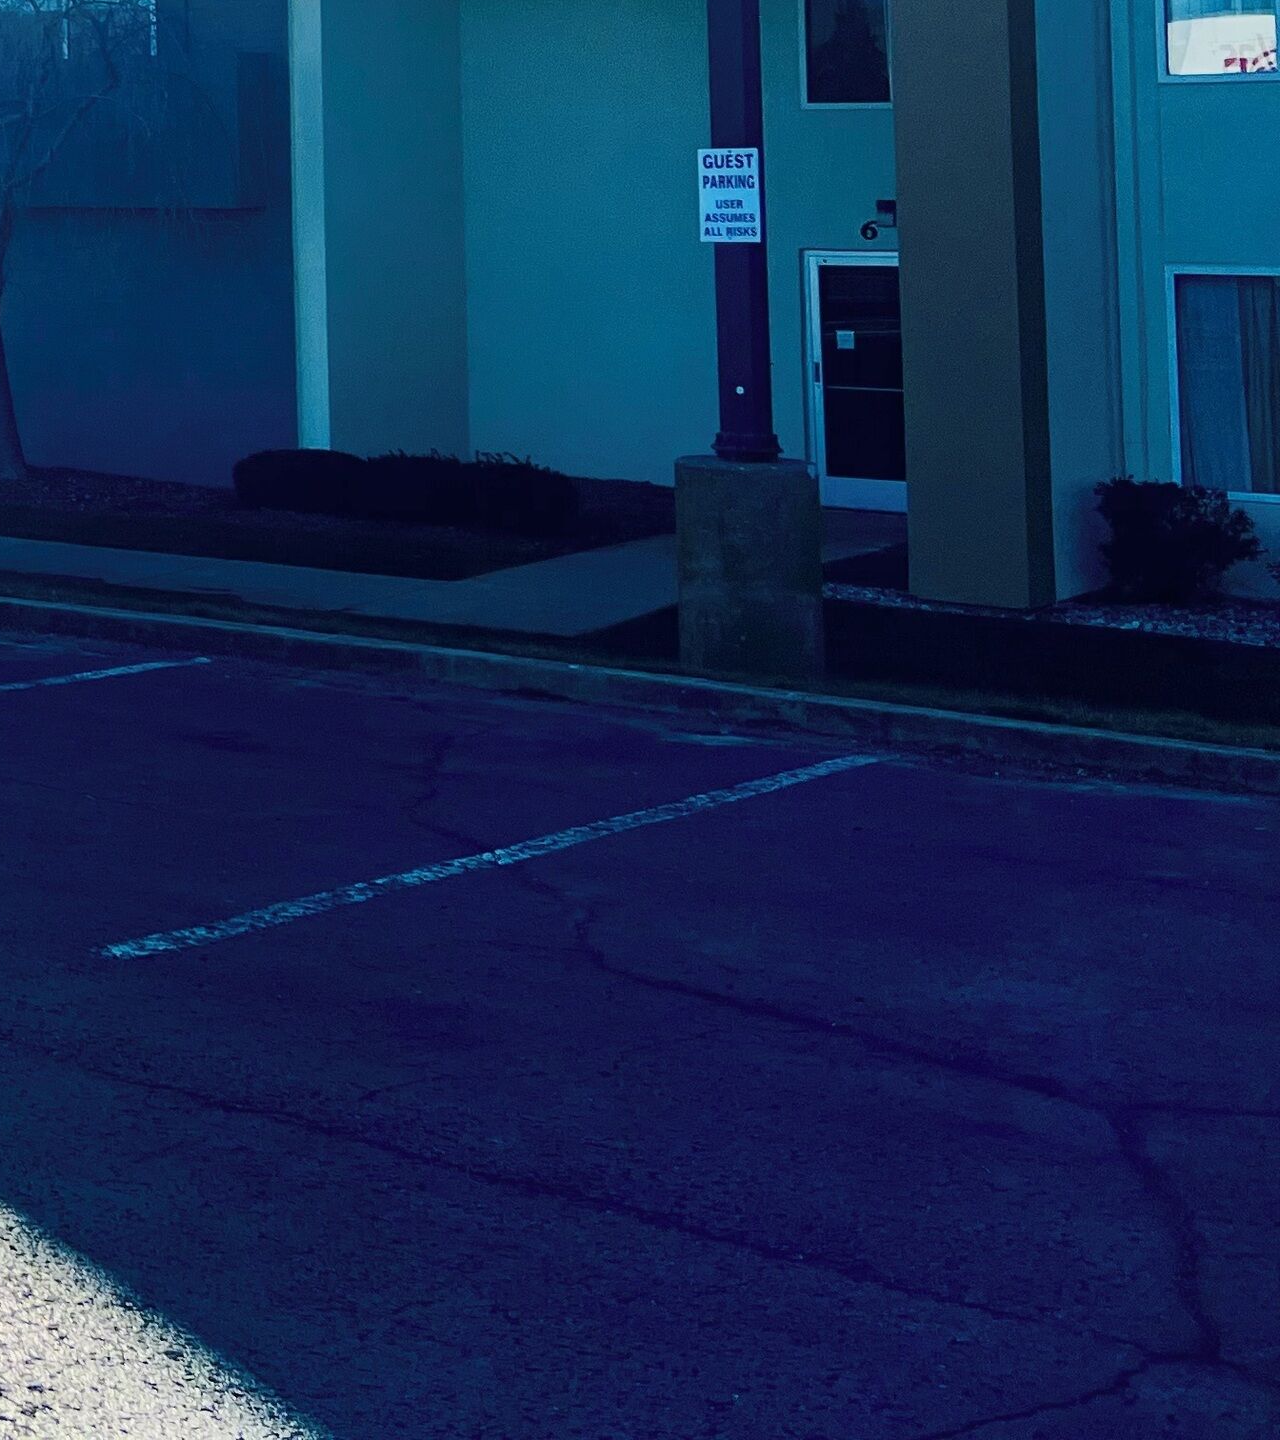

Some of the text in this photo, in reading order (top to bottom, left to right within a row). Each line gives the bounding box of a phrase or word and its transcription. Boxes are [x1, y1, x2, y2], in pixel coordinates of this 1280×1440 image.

[702, 153, 754, 169] GUEST
[702, 175, 755, 189] PARKING
[715, 200, 743, 210] USER
[705, 213, 756, 224] ASSUMES
[704, 226, 757, 237] ALL RISKS
[860, 220, 878, 240] 6
